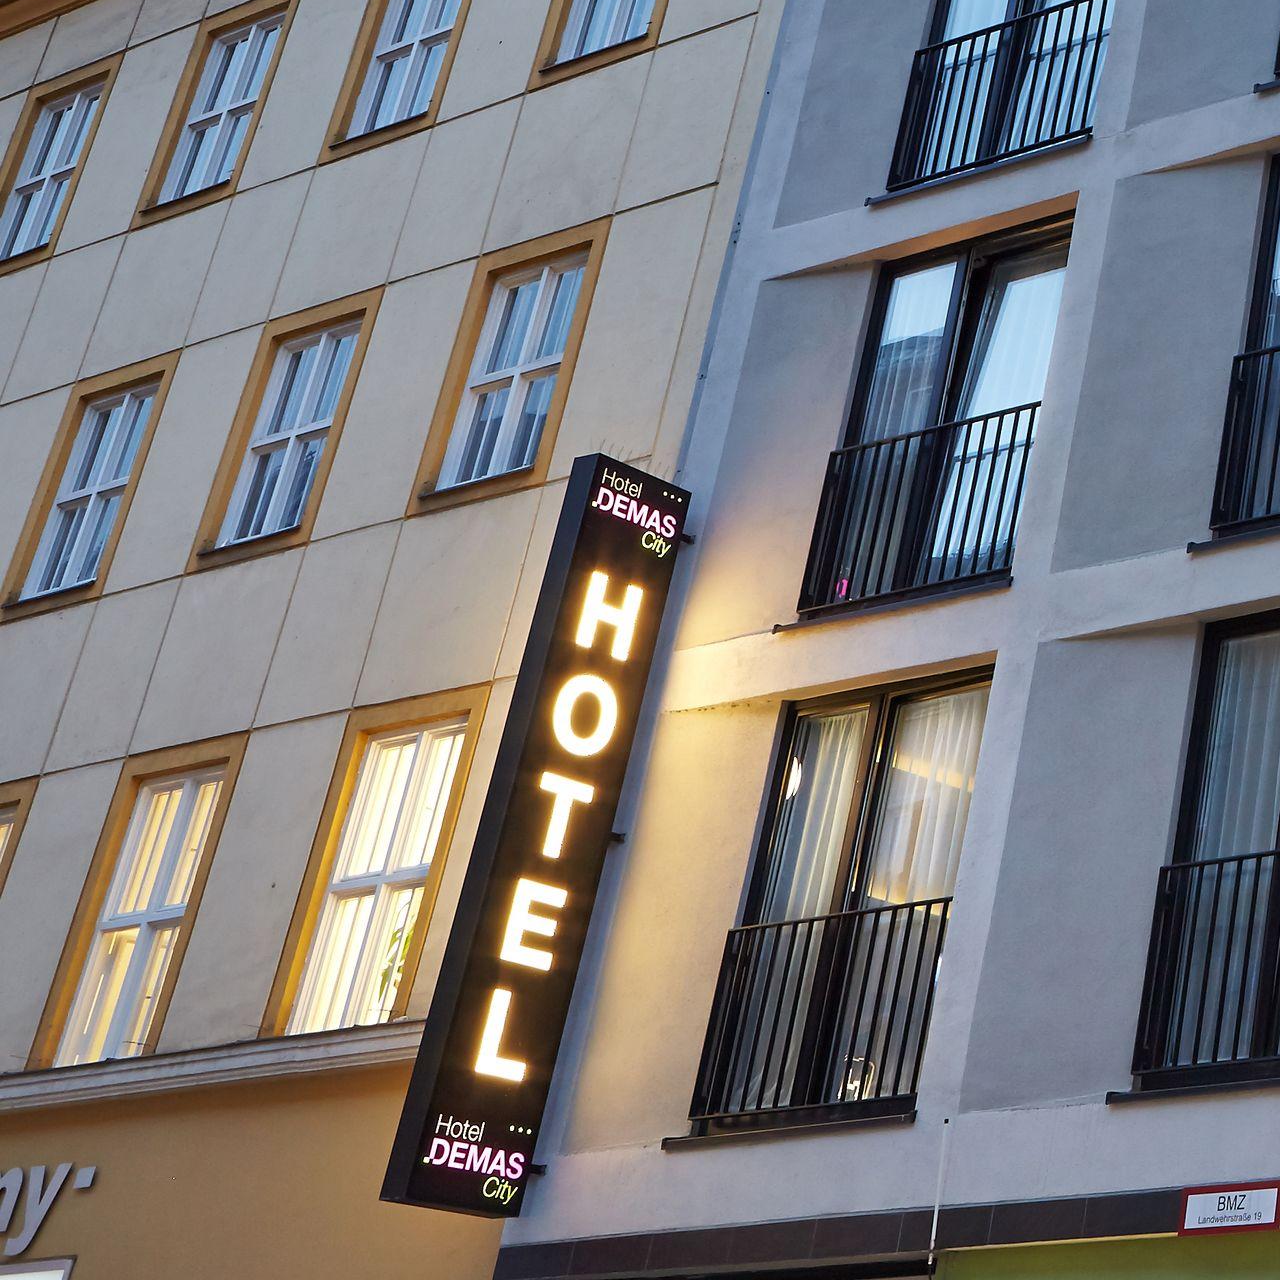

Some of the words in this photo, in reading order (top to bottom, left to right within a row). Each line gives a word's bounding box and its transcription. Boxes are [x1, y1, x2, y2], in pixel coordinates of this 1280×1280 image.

[601, 467, 643, 499] Hotel
[641, 530, 672, 558] City
[473, 569, 645, 1083] HOTEL
[435, 1113, 486, 1142] Hotel
[482, 1176, 519, 1205] City
[1217, 1194, 1247, 1212] BMZ
[1254, 1211, 1262, 1221] 19
